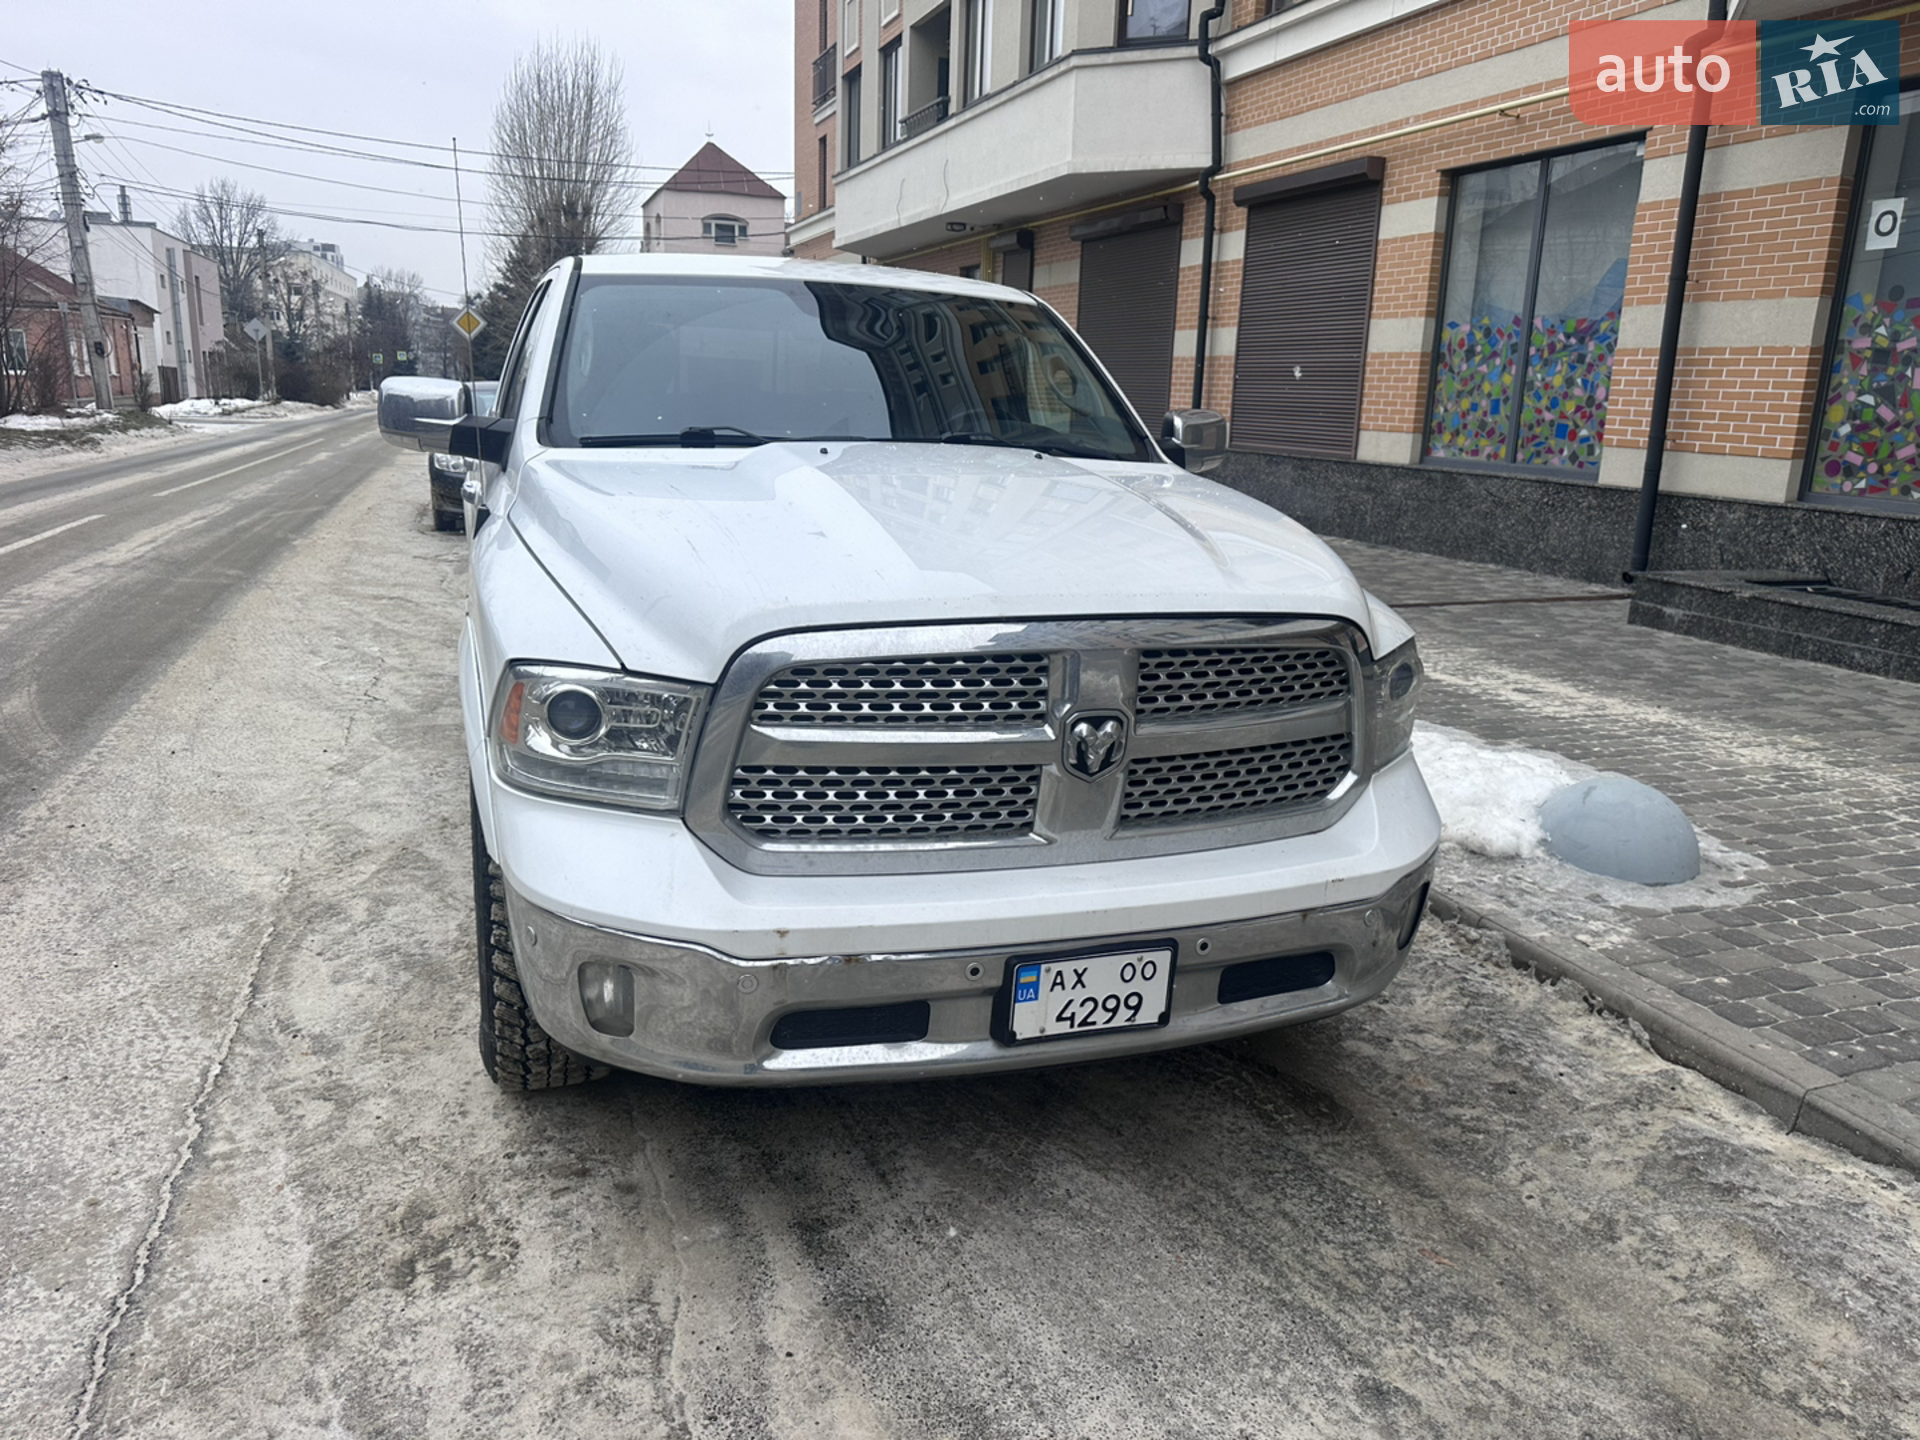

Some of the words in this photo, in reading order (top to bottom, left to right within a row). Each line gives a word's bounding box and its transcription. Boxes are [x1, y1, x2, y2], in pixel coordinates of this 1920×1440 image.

[1050, 967, 1088, 992] AX
[1018, 988, 1035, 1000] UA
[1055, 991, 1143, 1029] 4299
